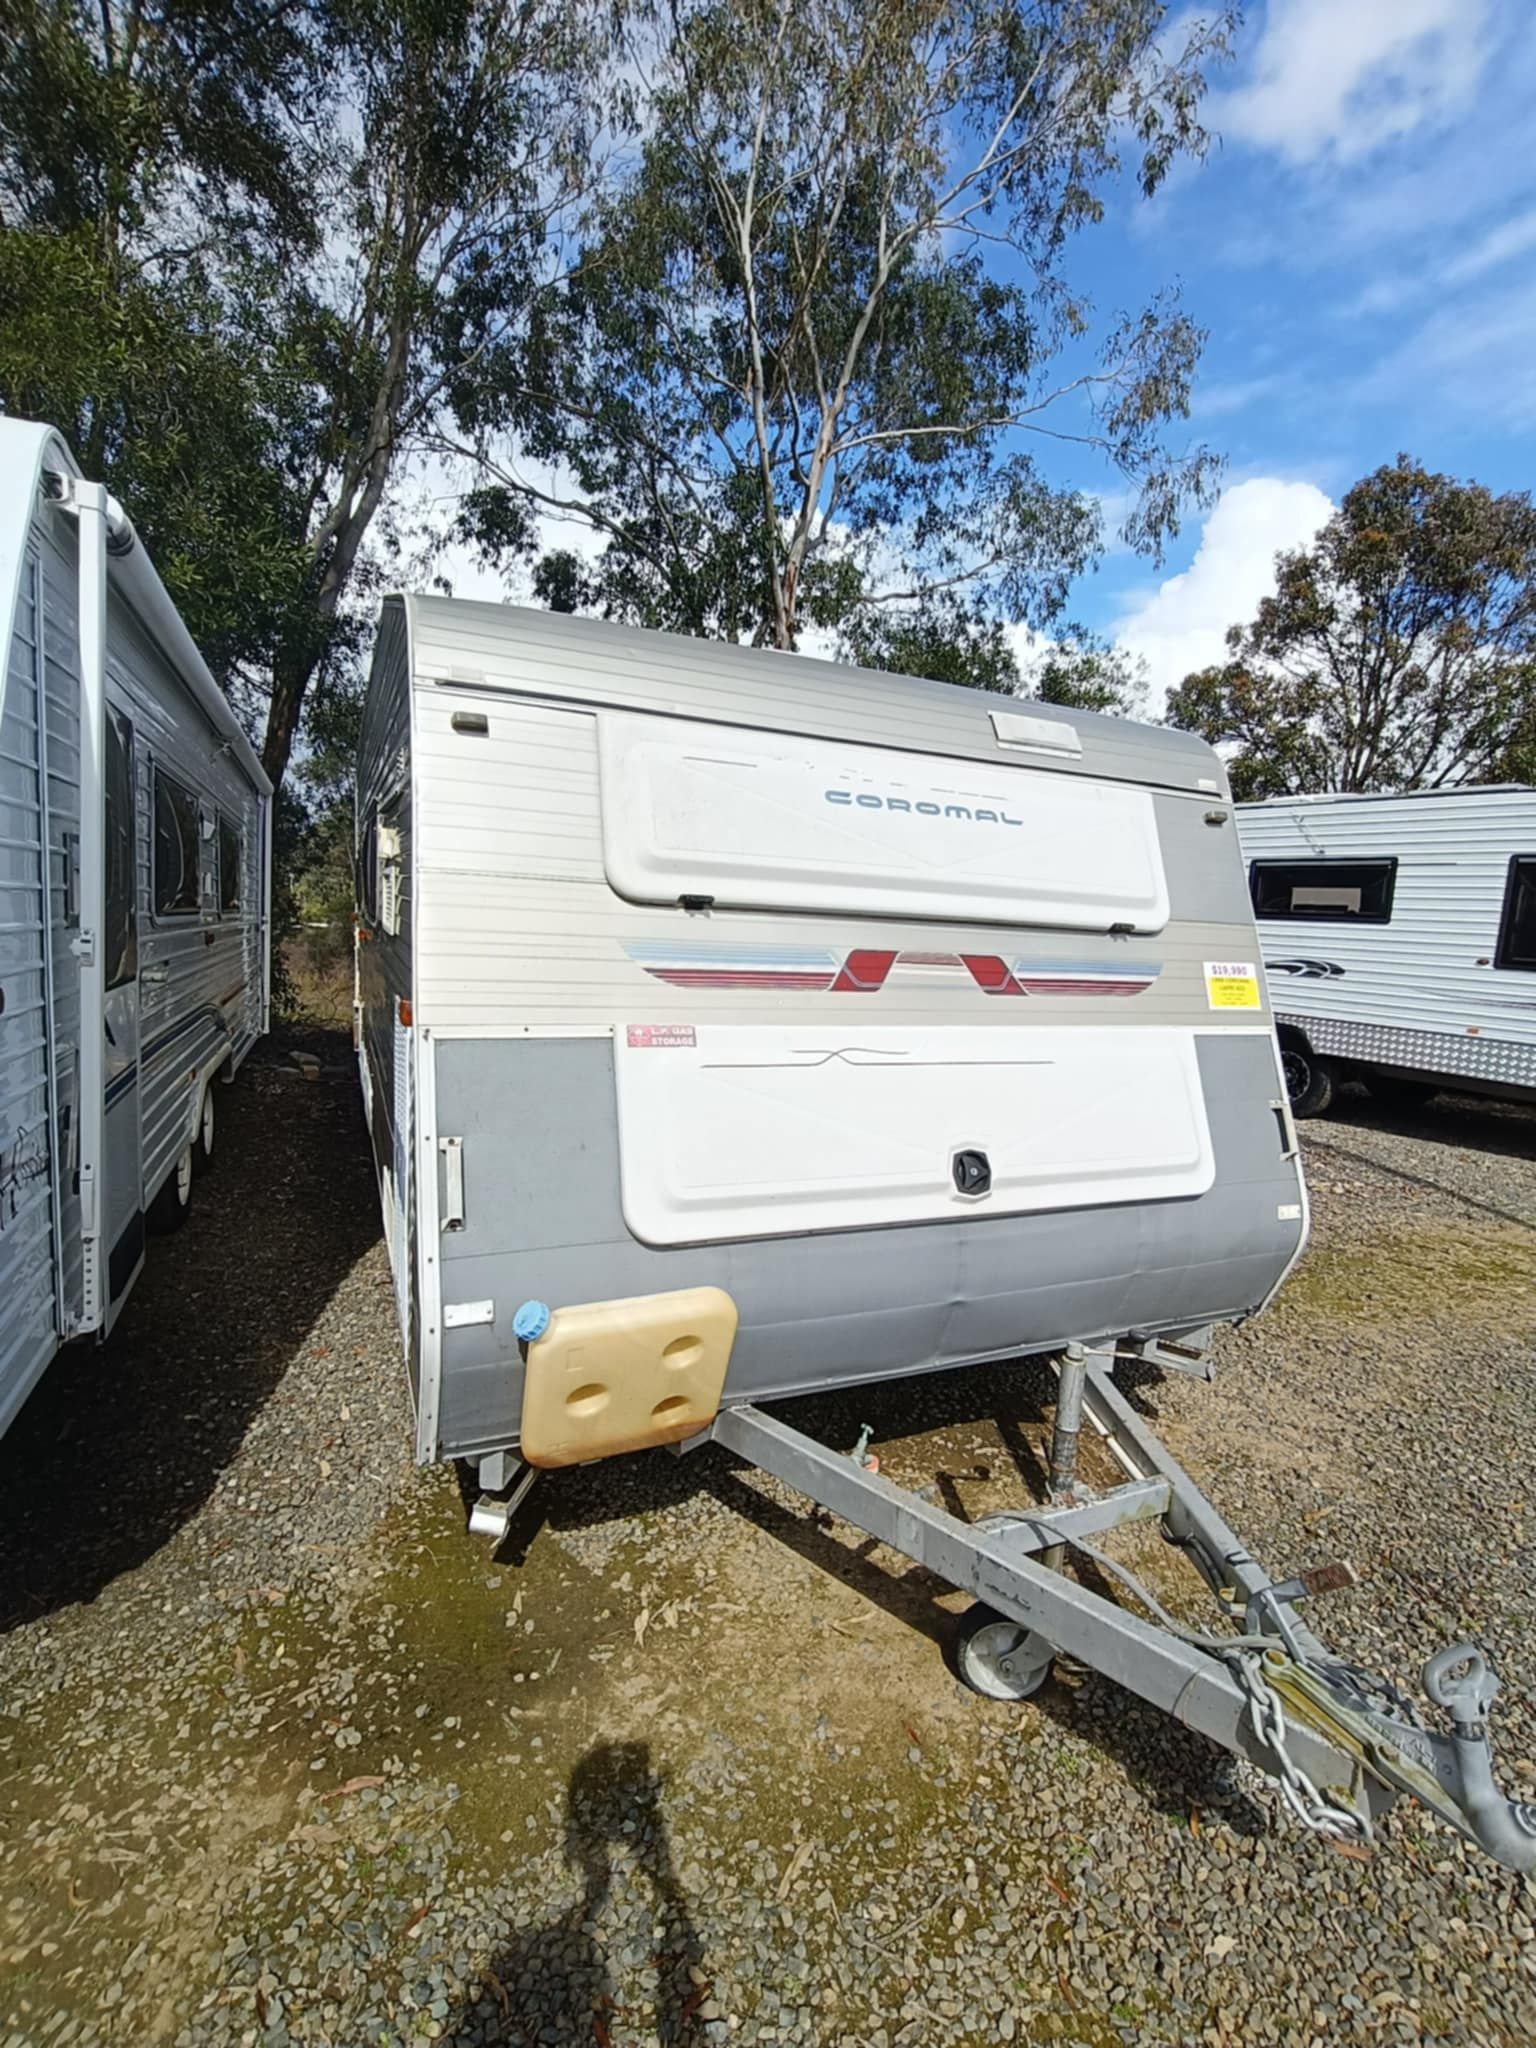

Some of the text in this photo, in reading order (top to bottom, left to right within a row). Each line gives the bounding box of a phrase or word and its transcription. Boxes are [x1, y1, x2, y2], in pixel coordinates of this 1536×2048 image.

[825, 790, 1024, 826] COROMAL
[671, 1026, 693, 1035] GAS
[651, 1037, 694, 1046] STORAGE
